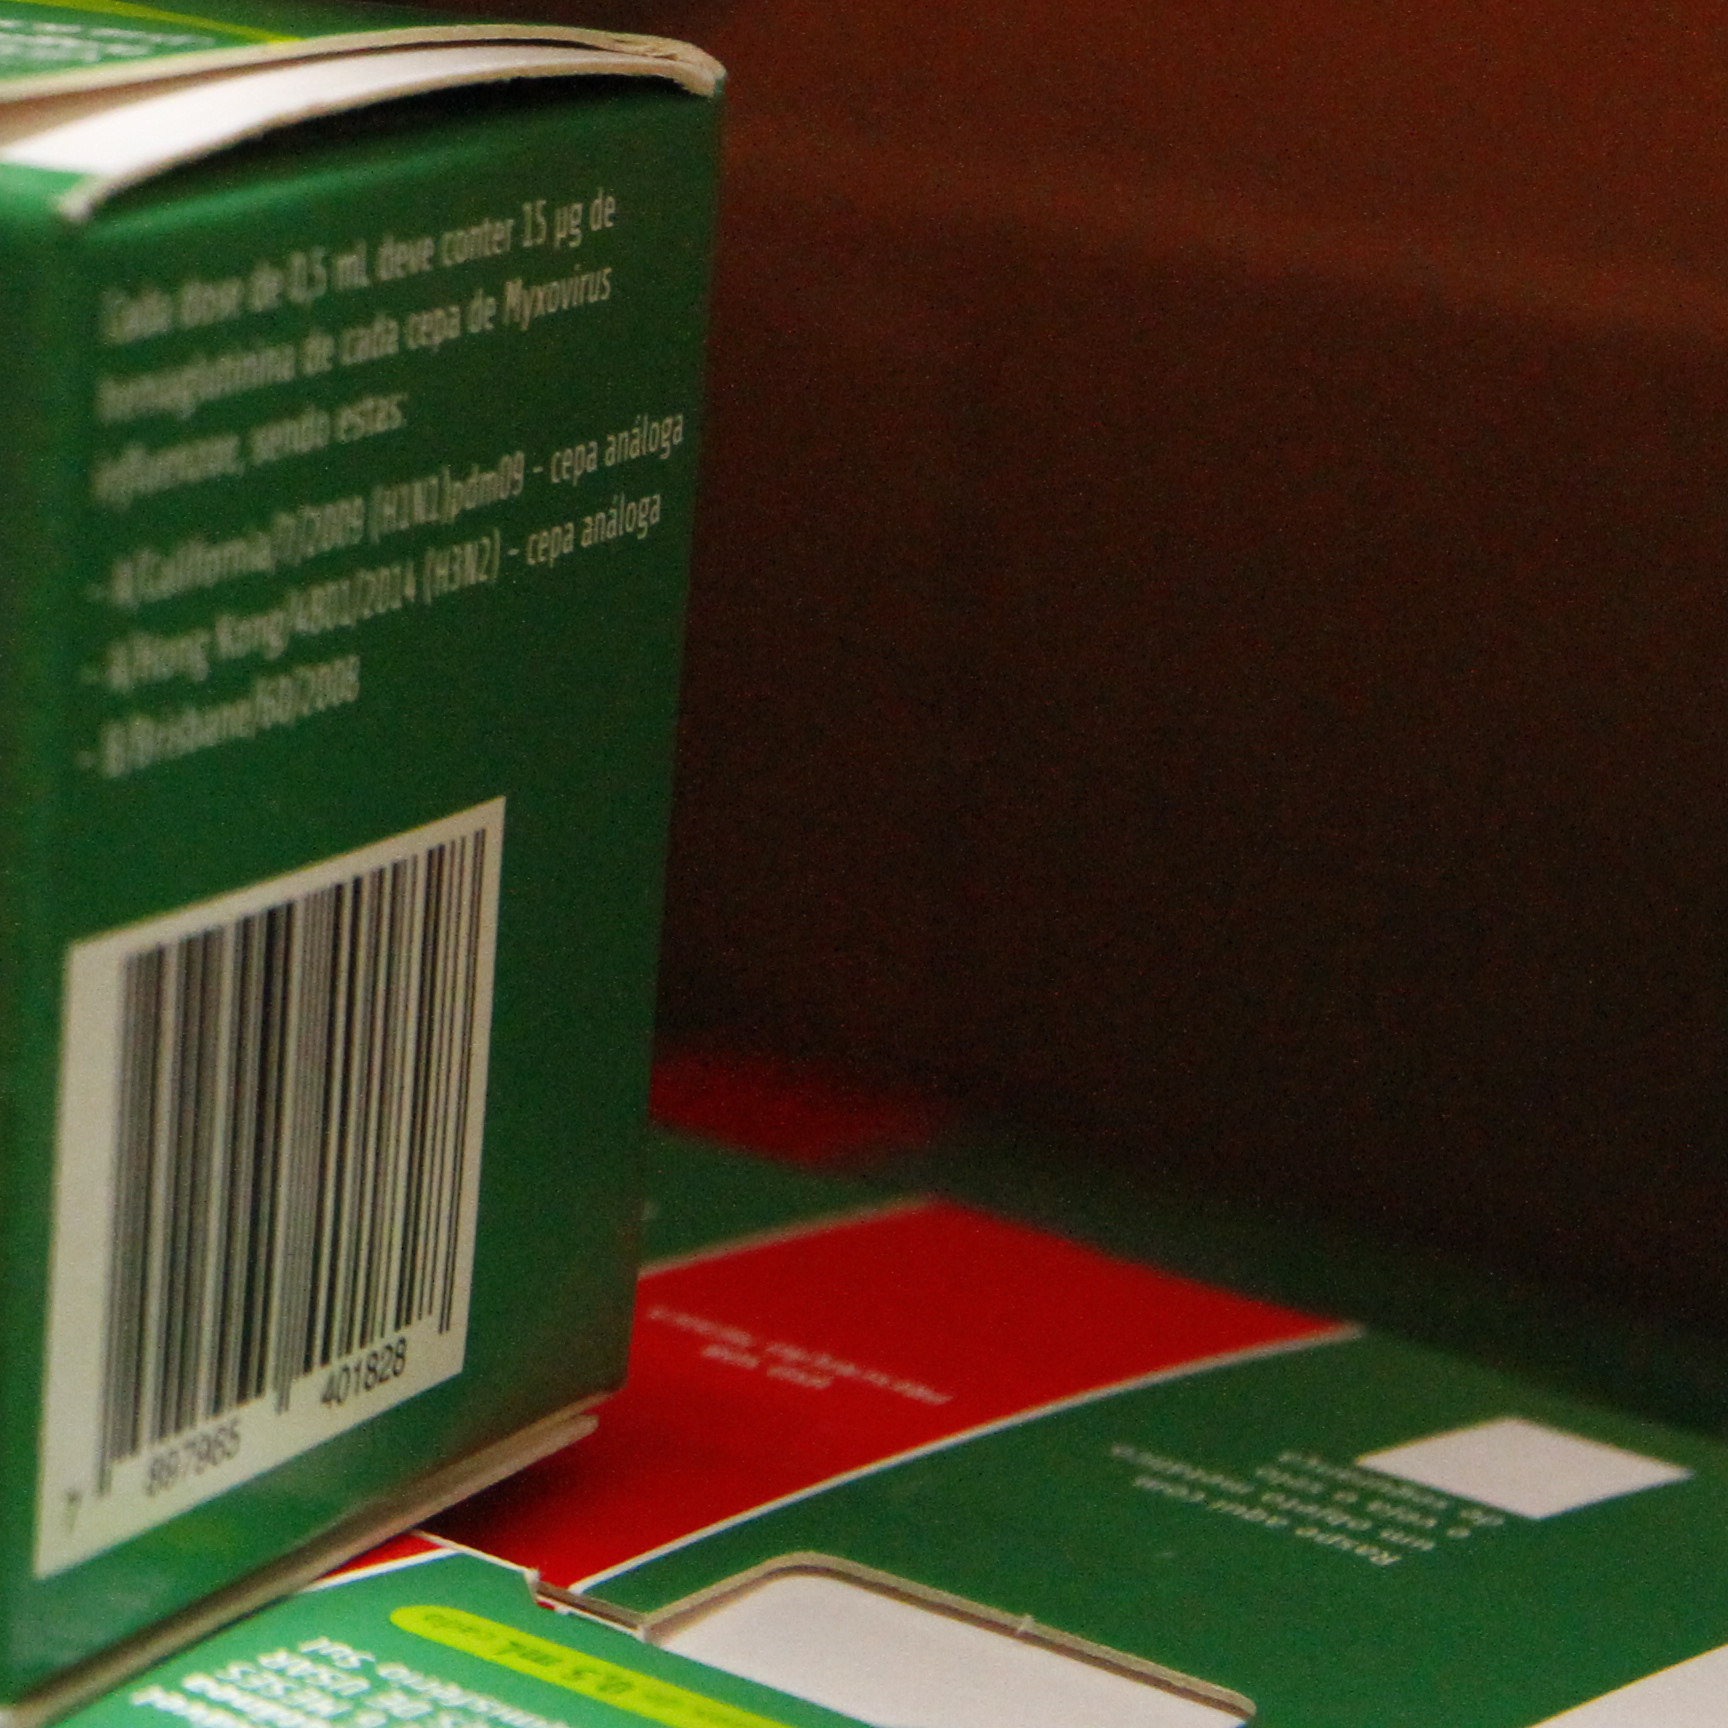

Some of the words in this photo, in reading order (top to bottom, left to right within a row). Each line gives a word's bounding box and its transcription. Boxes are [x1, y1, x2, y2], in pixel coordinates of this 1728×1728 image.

[375, 234, 435, 282] deve
[439, 217, 515, 268] conter
[520, 198, 548, 249] 15
[553, 201, 585, 250] µg
[589, 186, 617, 232] de
[402, 304, 462, 355] cepa
[465, 286, 497, 335] de
[549, 440, 599, 488] cepa
[604, 413, 685, 466] análoga
[422, 525, 501, 607] (H3N2)
[525, 529, 575, 569] cepa
[580, 492, 662, 544] análoga
